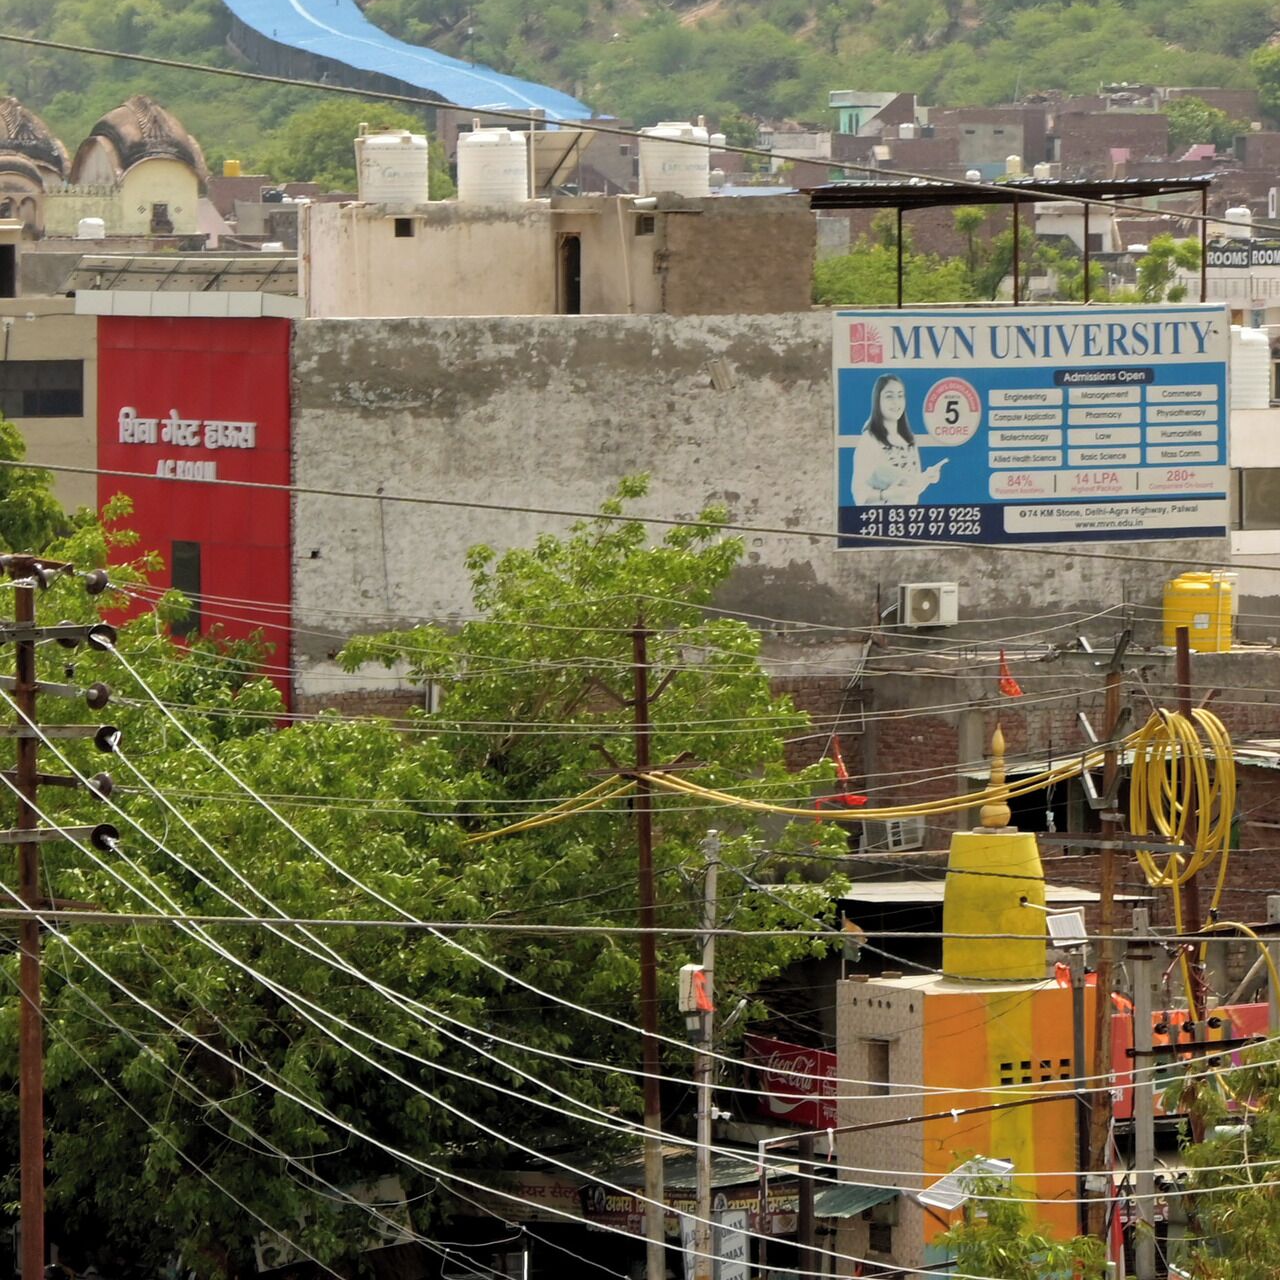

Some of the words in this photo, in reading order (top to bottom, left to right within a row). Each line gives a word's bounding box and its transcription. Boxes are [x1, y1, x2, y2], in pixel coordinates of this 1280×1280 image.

[1207, 251, 1248, 265] ROOMS
[889, 325, 976, 359] MVN
[988, 320, 1212, 360] UNIVERSITY
[1064, 371, 1117, 382] Admissions
[1118, 370, 1146, 382] Open
[1003, 393, 1047, 402] Engineering
[1081, 391, 1129, 401] Management
[1162, 390, 1202, 398] Commerce
[944, 400, 959, 425] 5
[1085, 411, 1122, 419] Pharmacy
[1157, 409, 1206, 418] Physiotherapy
[161, 408, 201, 447] गेस्ट
[935, 426, 969, 436] CRORE
[1000, 433, 1049, 442] Biotechnology
[1095, 432, 1112, 440] Law
[1080, 452, 1098, 461] Basic
[1100, 452, 1127, 460] Science
[156, 459, 175, 478] AC
[176, 460, 217, 481] ROOM
[1167, 470, 1196, 481] 280+
[1008, 474, 1032, 486] 84%
[1076, 473, 1089, 484] 14
[1094, 472, 1118, 484] LPA
[860, 509, 883, 522] +91
[888, 509, 905, 522] 83
[908, 508, 925, 521] 97
[928, 508, 945, 521] 97
[949, 507, 981, 521] 9225
[1028, 509, 1038, 517] 74
[1040, 509, 1053, 517] KM
[1085, 507, 1129, 517] Delhi-Agra
[1171, 504, 1199, 512] Palwal
[1075, 519, 1144, 528] www.mvn.edu.in
[860, 523, 883, 537] +91
[888, 523, 905, 536] 83
[908, 523, 925, 536] 97
[928, 522, 945, 536] 97
[949, 522, 981, 535] 9226
